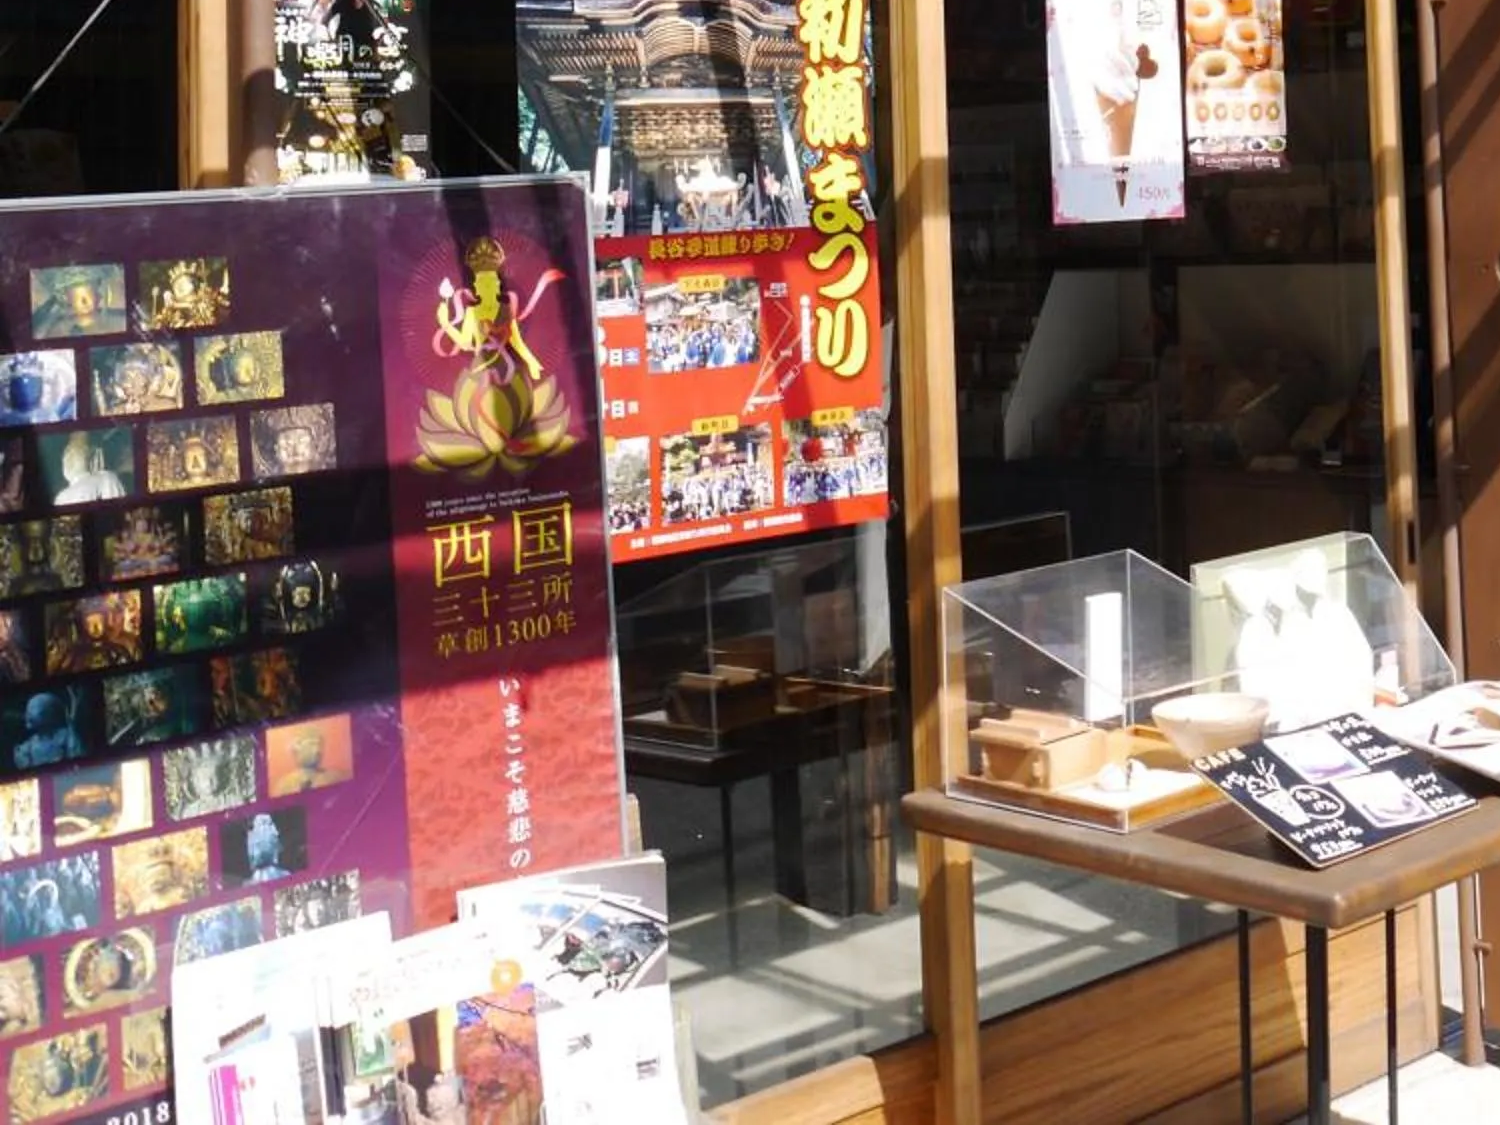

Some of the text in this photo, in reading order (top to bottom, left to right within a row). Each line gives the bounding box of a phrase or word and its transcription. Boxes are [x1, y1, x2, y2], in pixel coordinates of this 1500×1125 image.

[427, 502, 572, 588] 西国
[433, 572, 572, 625] 三十三所
[499, 678, 531, 869] いまこそ慈悲の
[1194, 748, 1246, 771] CAFE
